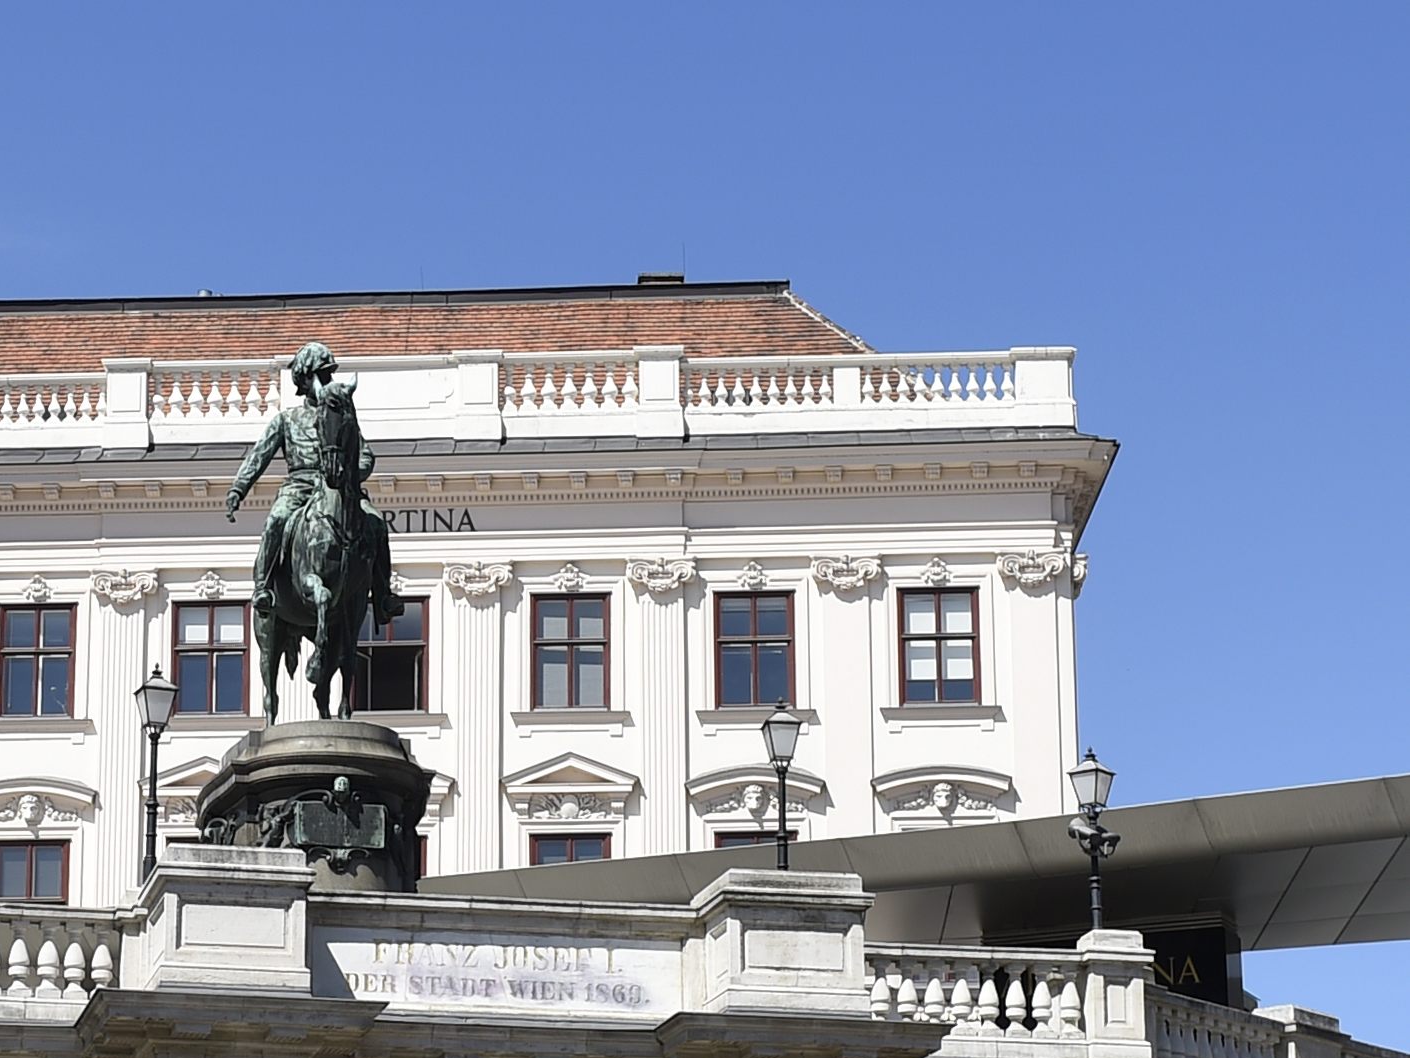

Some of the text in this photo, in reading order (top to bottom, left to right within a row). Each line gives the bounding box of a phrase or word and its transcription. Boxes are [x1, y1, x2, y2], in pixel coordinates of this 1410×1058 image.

[380, 507, 477, 533] RTINA
[372, 938, 479, 968] FRANZ
[493, 945, 592, 973] JOSEF
[408, 975, 496, 998] STADT
[509, 979, 576, 1002] WIEN
